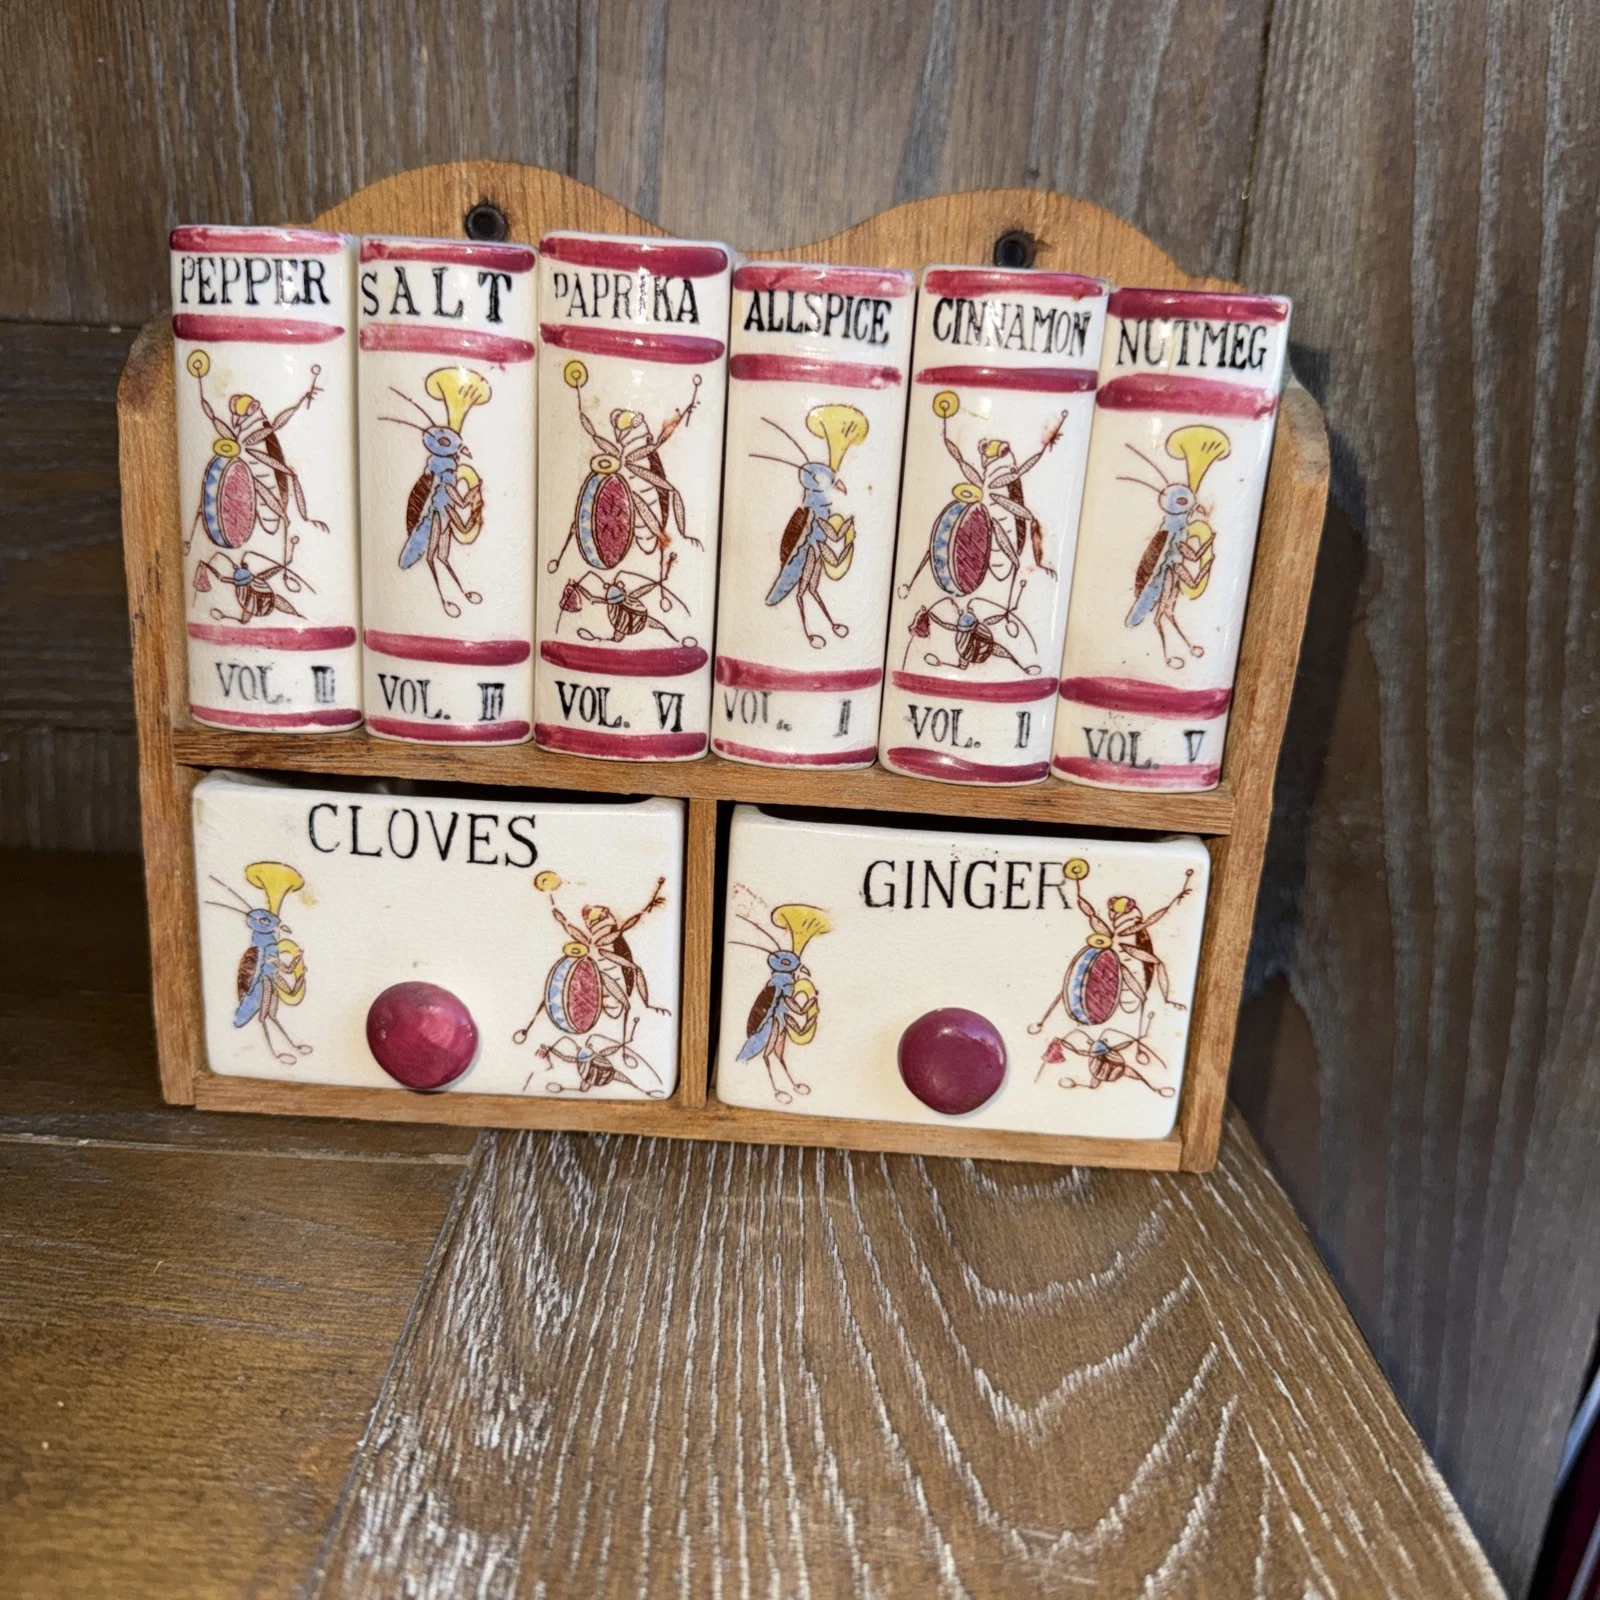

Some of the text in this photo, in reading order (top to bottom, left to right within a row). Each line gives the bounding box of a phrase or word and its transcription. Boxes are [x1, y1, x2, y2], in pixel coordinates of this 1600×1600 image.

[180, 254, 331, 306] PEPPER
[361, 266, 512, 323] SALT
[553, 272, 700, 325] PAPRIKA
[744, 288, 892, 346] ALLSPICE
[932, 297, 1092, 358] CINNAMON
[1116, 318, 1268, 371] NUTMEG
[215, 662, 292, 704] VOL.
[377, 673, 451, 721] VOL.
[554, 680, 685, 732] VOL. VI
[906, 704, 982, 749] VOL.
[1082, 727, 1206, 770] VOL. V
[307, 804, 538, 868] CLOVES
[862, 858, 1072, 911] GINGER
